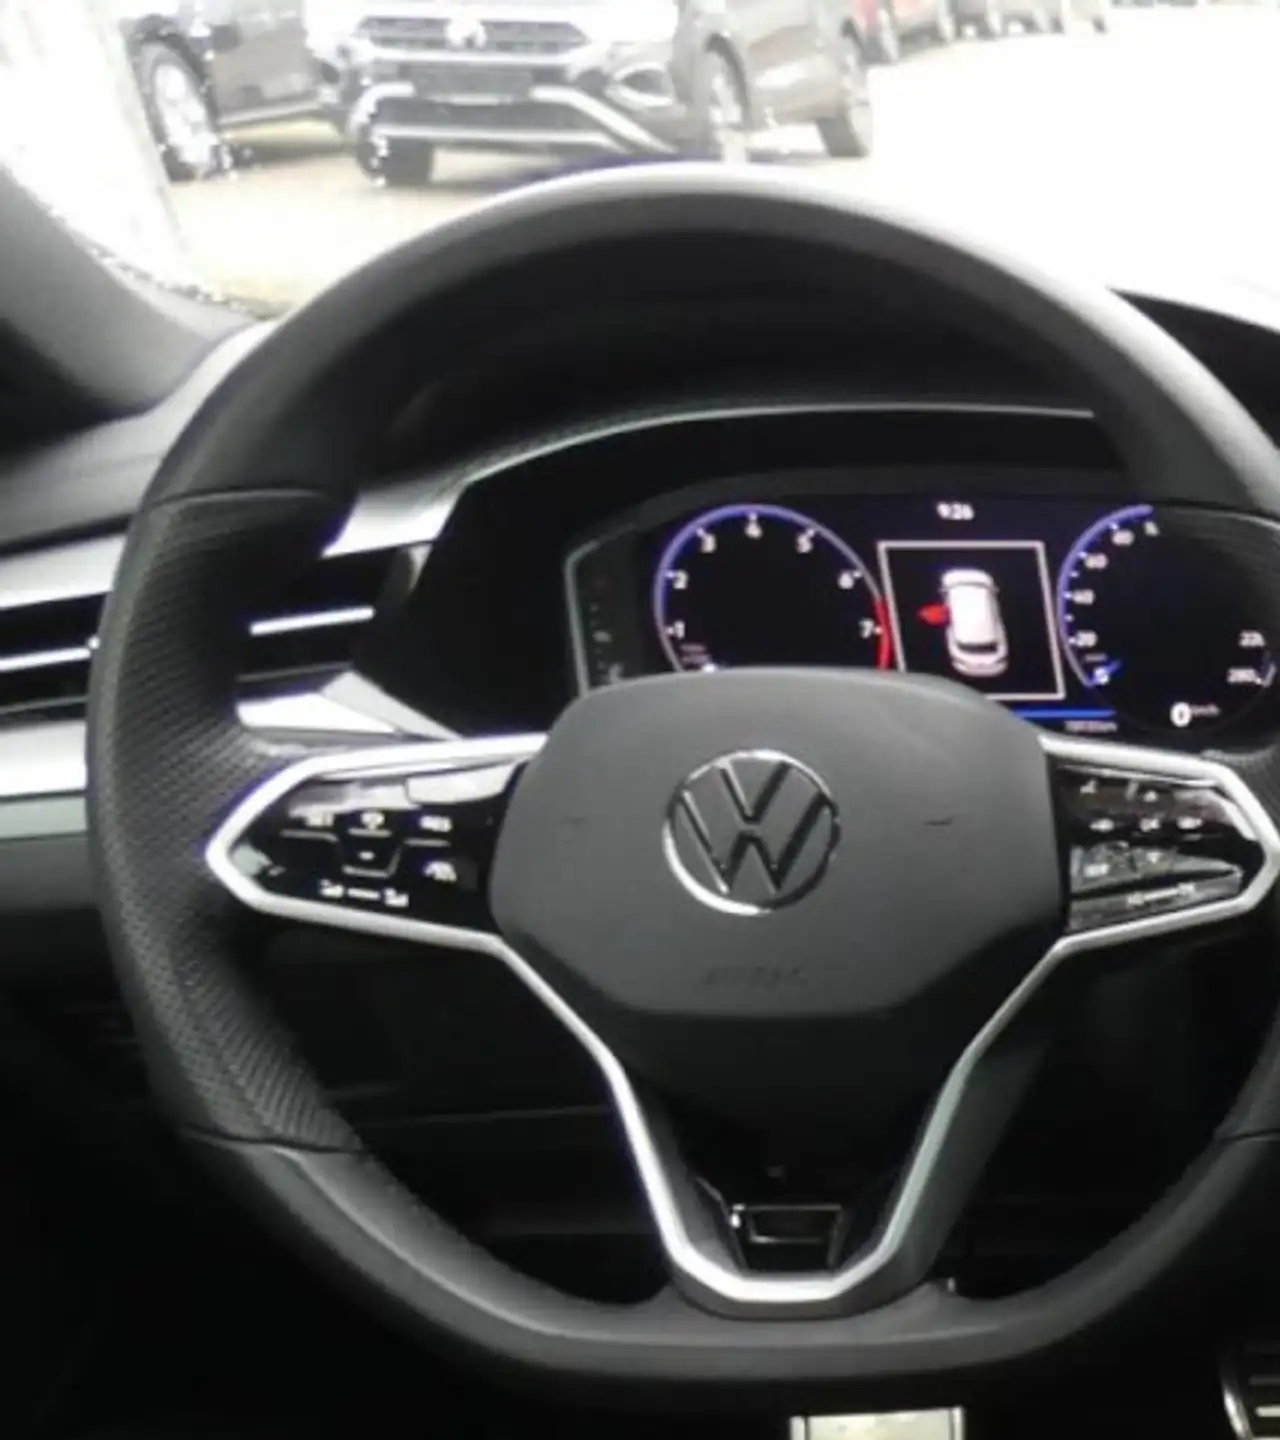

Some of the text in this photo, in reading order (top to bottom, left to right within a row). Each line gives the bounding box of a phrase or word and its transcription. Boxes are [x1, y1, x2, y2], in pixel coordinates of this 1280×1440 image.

[744, 521, 763, 540] 4
[701, 532, 718, 554] 3
[796, 533, 814, 554] 5
[672, 568, 689, 591] 2
[837, 569, 855, 590] 6
[673, 619, 686, 640] 1
[858, 618, 875, 640] 7
[1170, 702, 1192, 728] 0
[661, 749, 842, 917] VW
